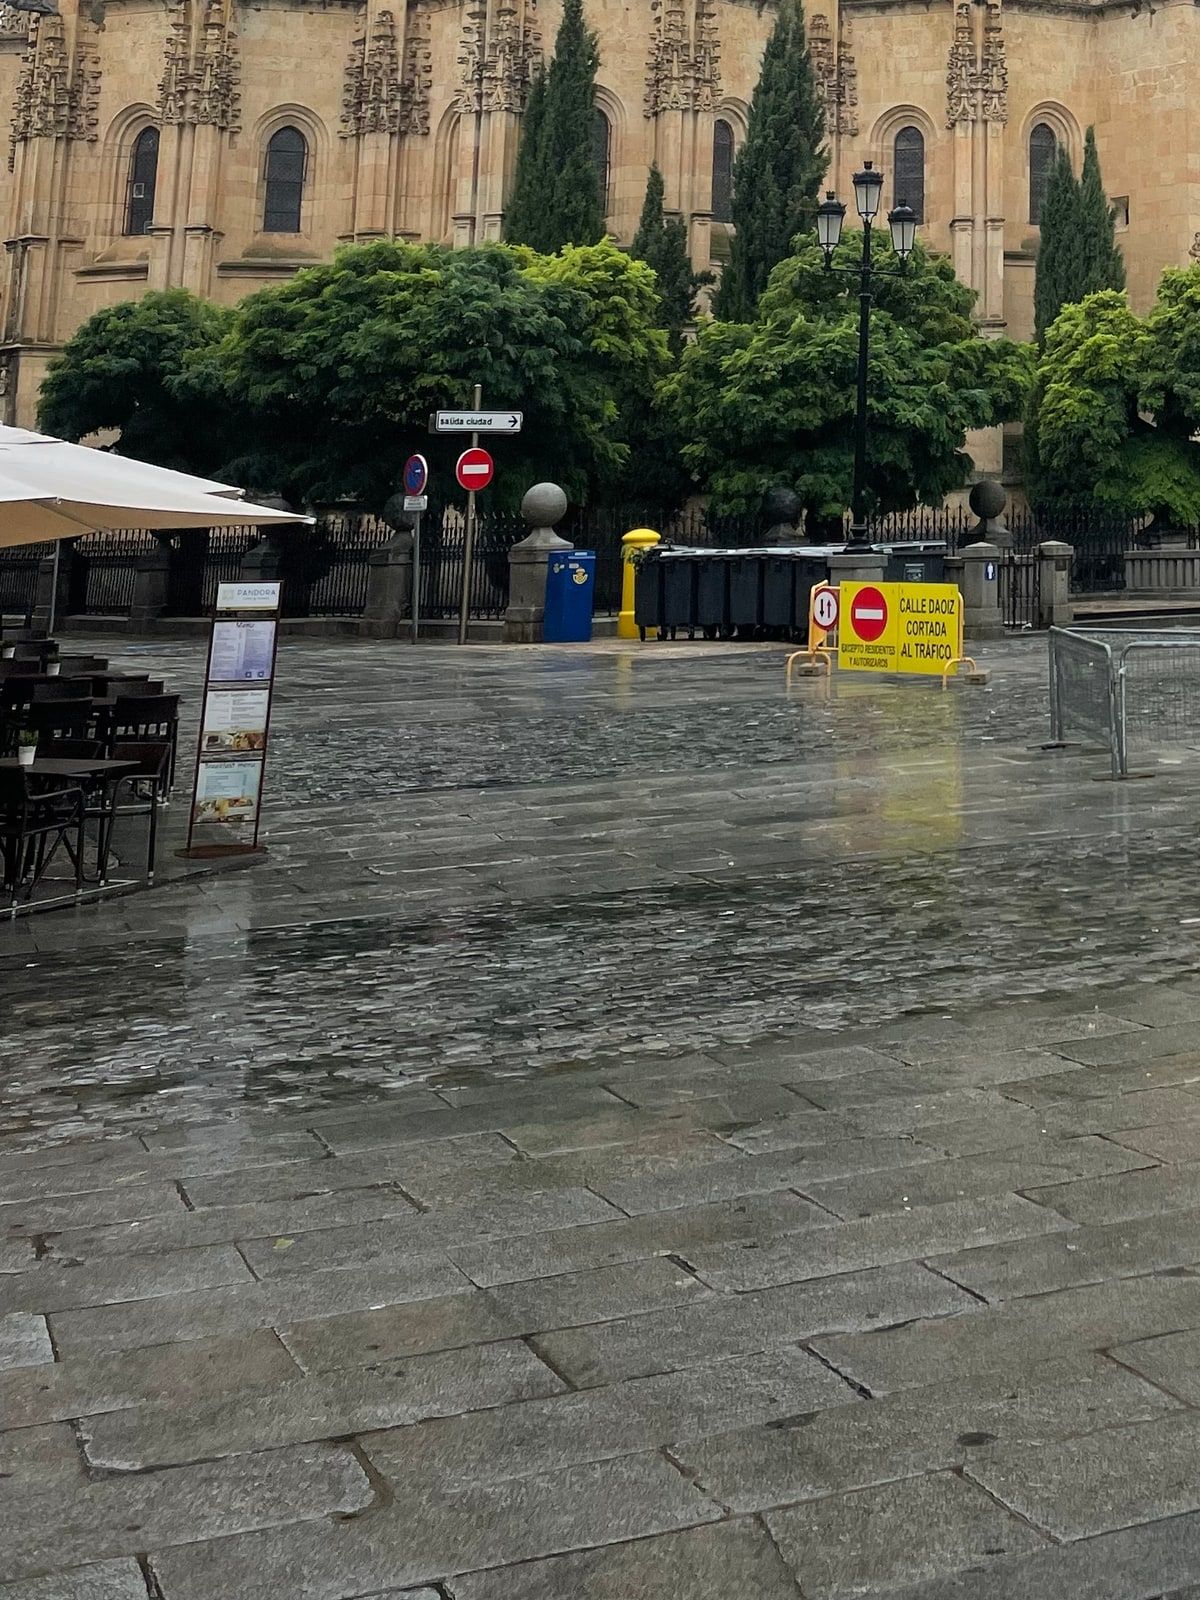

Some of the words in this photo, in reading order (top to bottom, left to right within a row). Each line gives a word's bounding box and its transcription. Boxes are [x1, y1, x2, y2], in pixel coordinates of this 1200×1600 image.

[440, 418, 464, 426] salida
[466, 418, 493, 426] ciudad
[900, 598, 926, 613] CALLE
[929, 599, 954, 614] DAOIZ
[907, 621, 946, 636] CORTADA
[842, 644, 864, 653] EXCEPTO
[865, 645, 895, 655] RESIDENTES
[901, 643, 912, 657] AL
[915, 640, 951, 659] TRÁFICO
